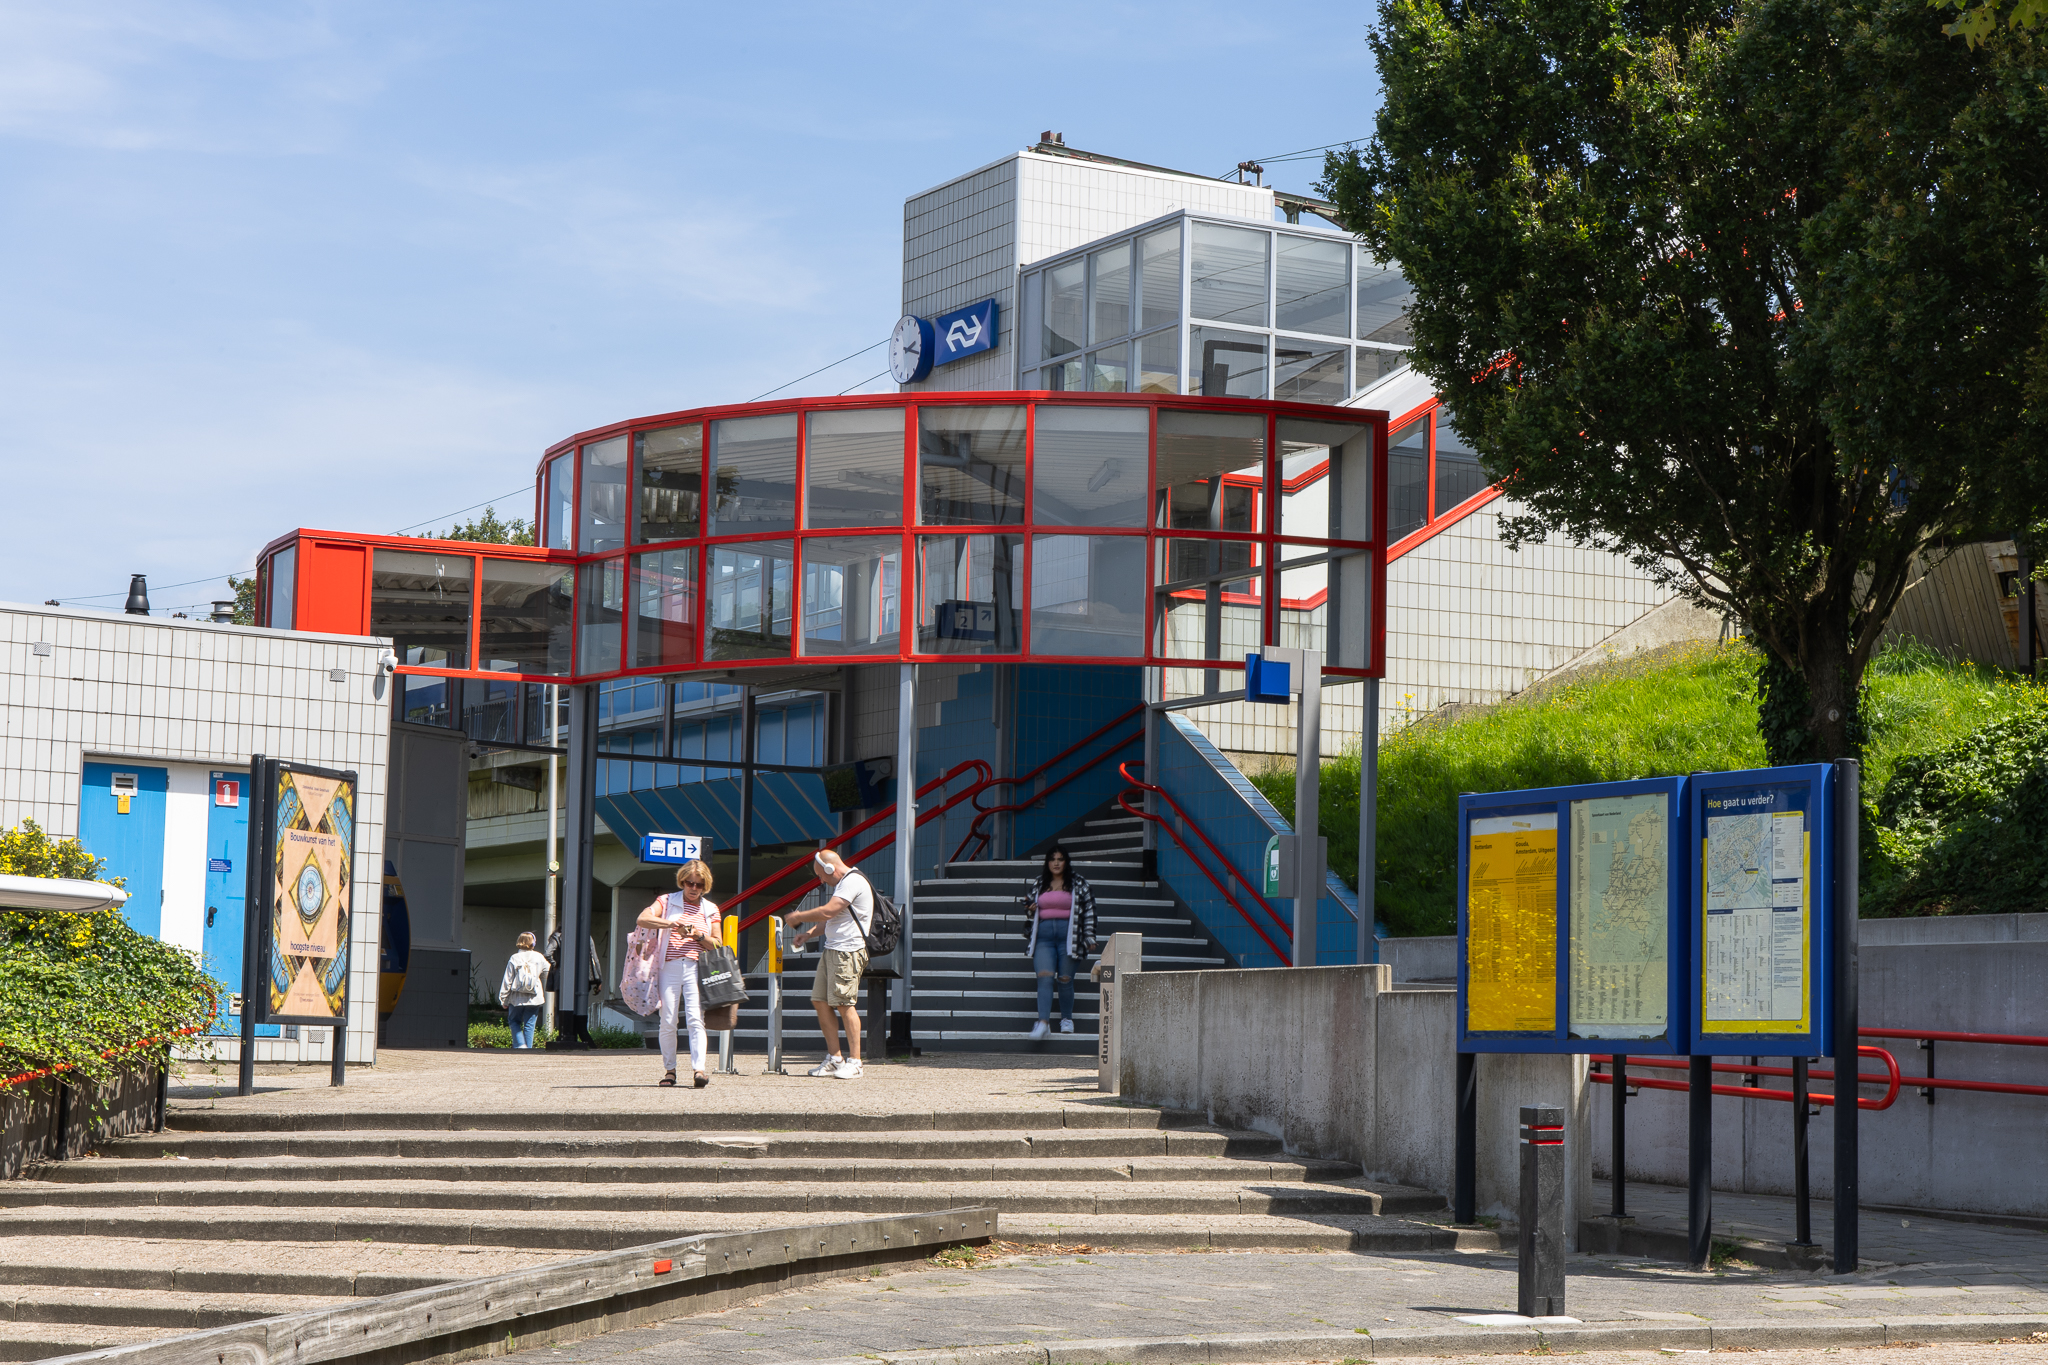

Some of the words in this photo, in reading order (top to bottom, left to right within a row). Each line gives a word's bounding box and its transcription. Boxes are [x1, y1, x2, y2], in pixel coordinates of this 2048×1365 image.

[960, 616, 968, 627] 2
[1707, 799, 1721, 809] Hoe
[1723, 797, 1739, 810] gaat
[1747, 794, 1774, 806] verder?
[290, 832, 318, 844] Bouwkunst
[673, 847, 677, 855] 1
[290, 941, 310, 953] hoogste
[310, 942, 326, 952] niveau
[1101, 1016, 1109, 1064] dunea
